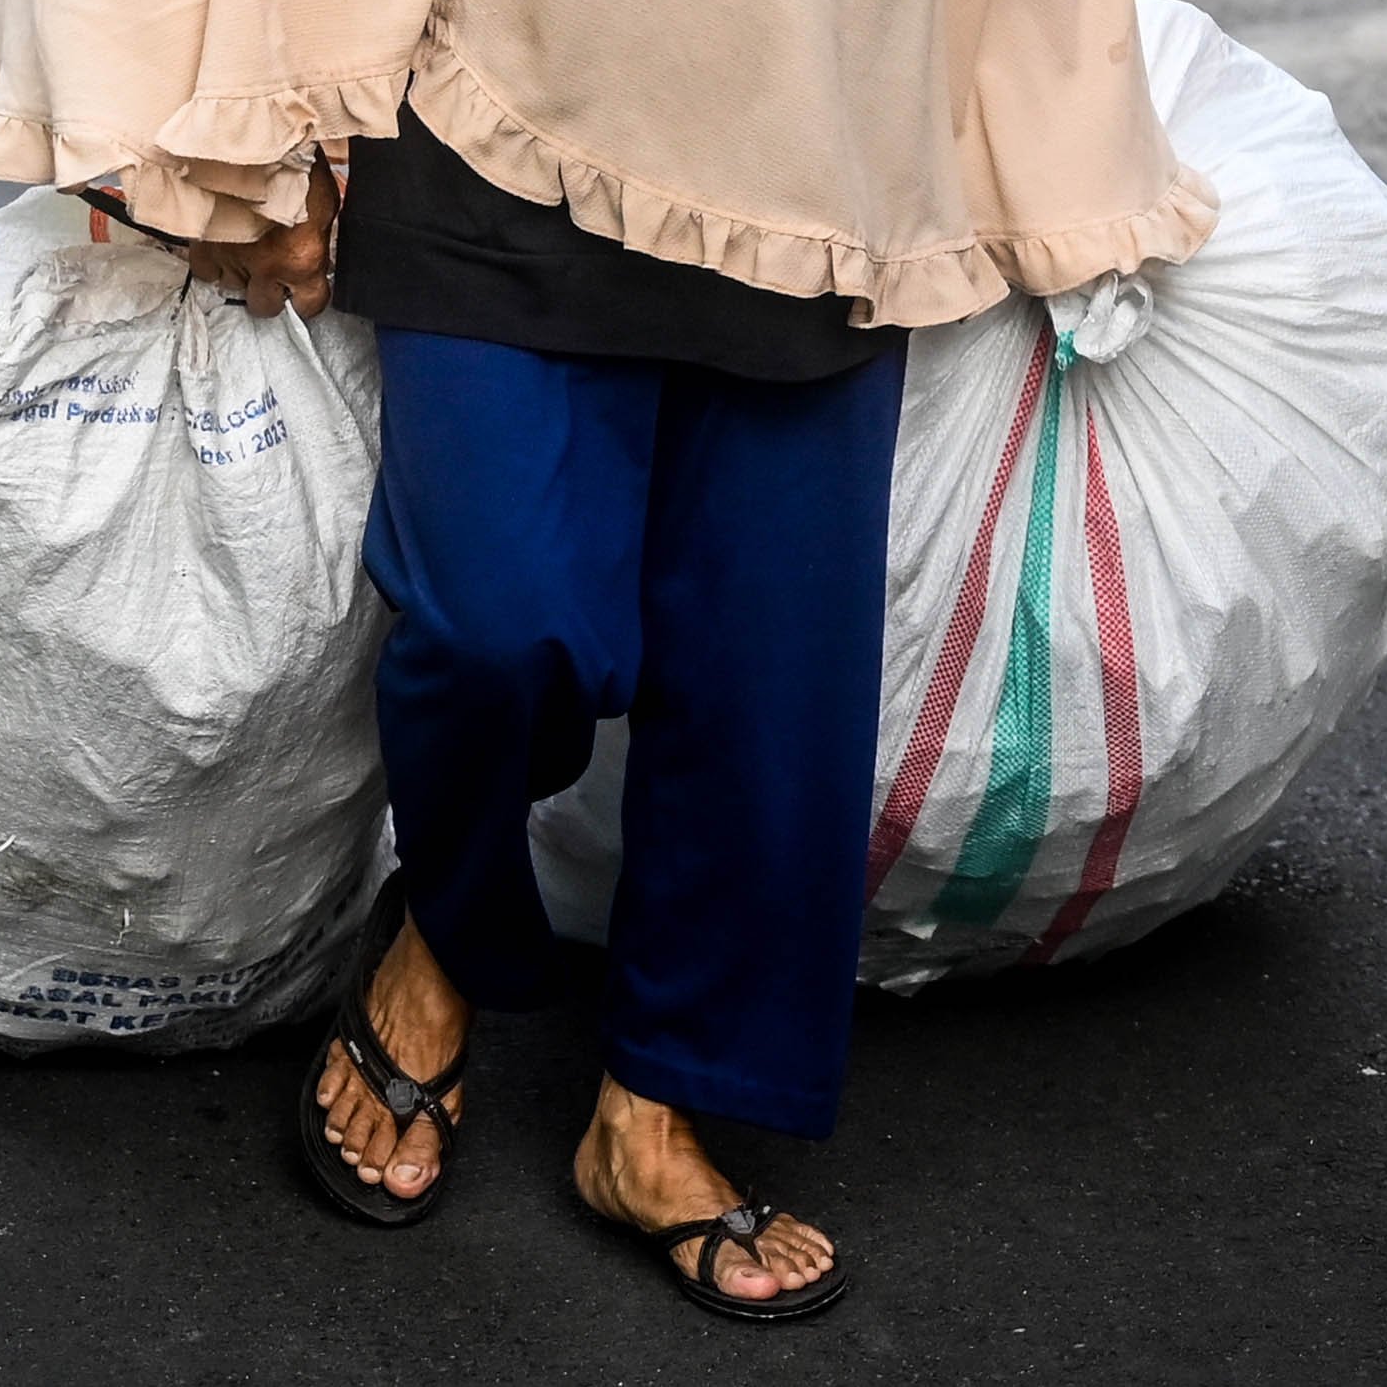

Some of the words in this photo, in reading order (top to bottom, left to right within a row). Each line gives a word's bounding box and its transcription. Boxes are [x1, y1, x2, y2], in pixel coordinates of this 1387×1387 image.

[67, 402, 162, 424] Produksi
[251, 419, 288, 453] 2023
[52, 967, 181, 988] BERAS
[19, 985, 122, 1007] ASAL
